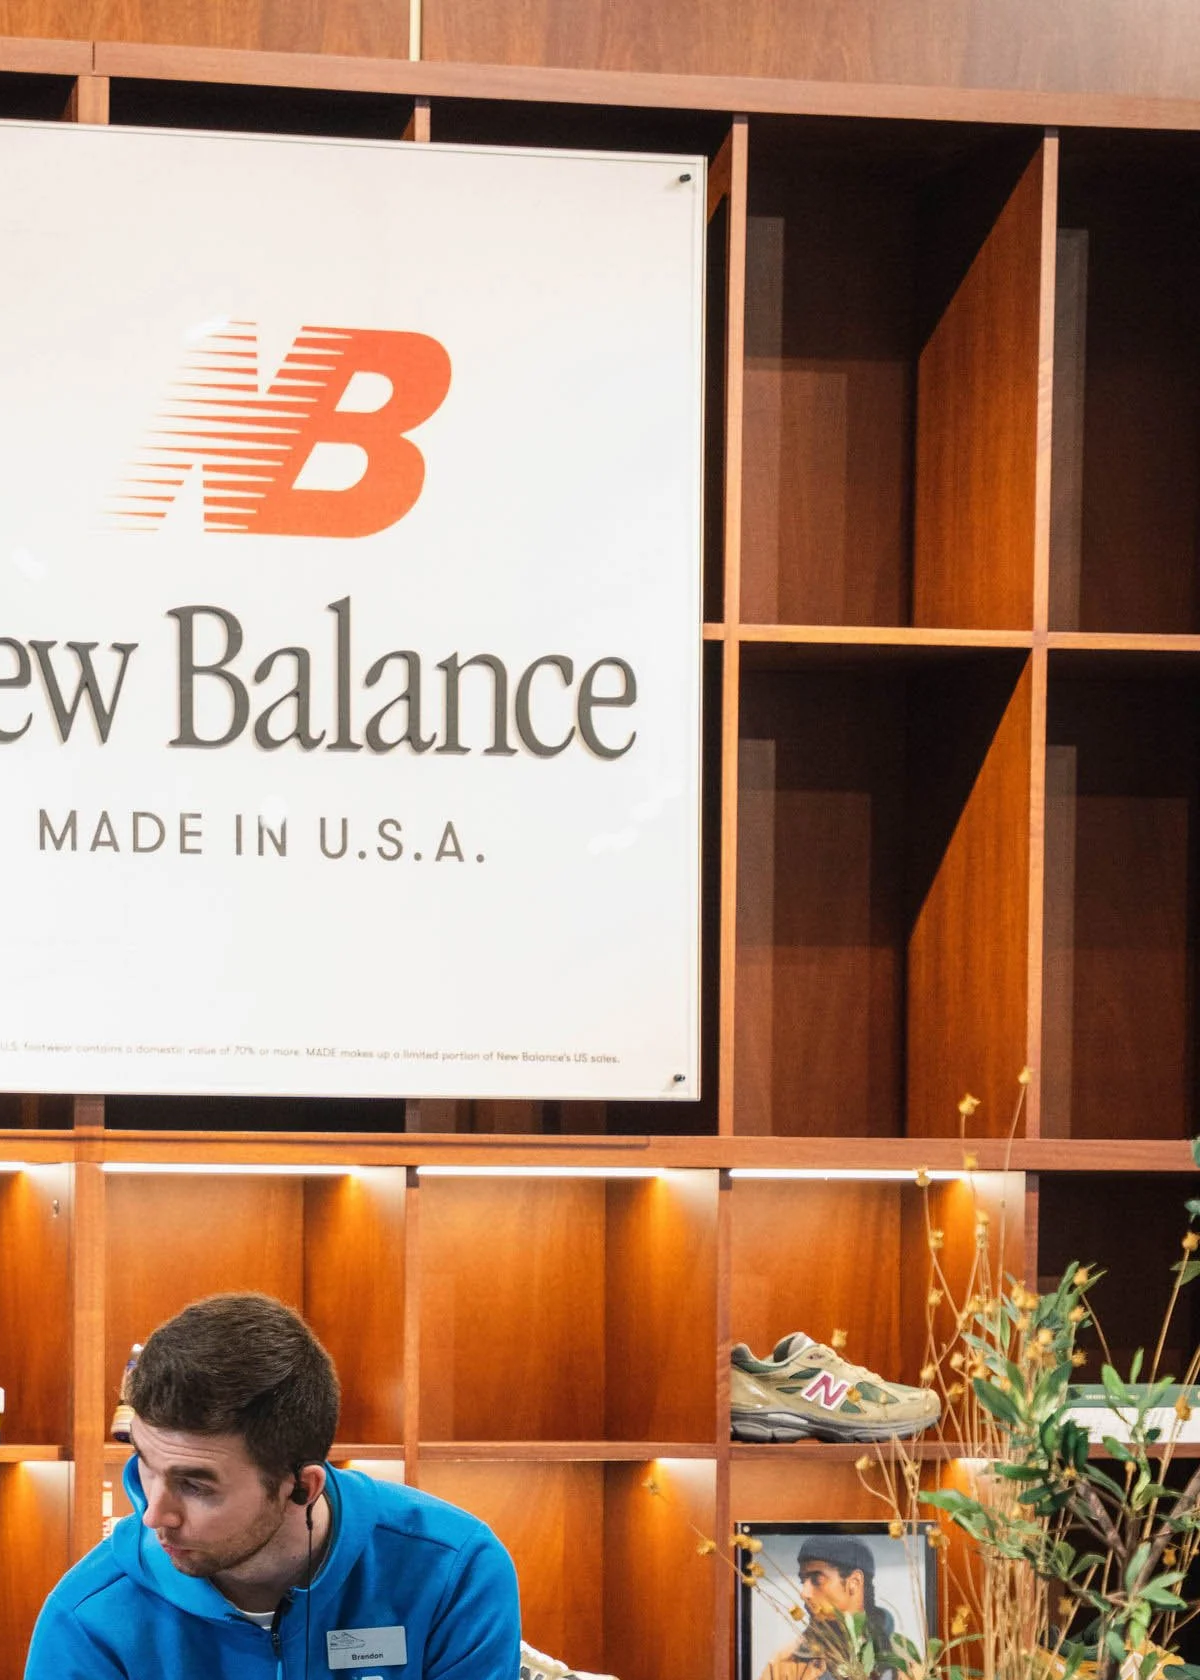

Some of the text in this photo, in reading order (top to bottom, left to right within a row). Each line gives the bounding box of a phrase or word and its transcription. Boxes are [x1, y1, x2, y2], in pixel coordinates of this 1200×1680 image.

[166, 594, 640, 762] Balance
[37, 809, 488, 864] MADE IN U.S.A.
[76, 1044, 122, 1053] contains
[136, 1045, 182, 1054] domestic
[188, 1046, 216, 1054] value
[219, 1046, 230, 1055] of
[233, 1046, 255, 1055] 70%
[306, 1048, 337, 1057] MADE
[340, 1049, 373, 1058] makes
[377, 1051, 390, 1061] up
[403, 1049, 439, 1059] limited
[442, 1052, 480, 1062] portion
[483, 1052, 494, 1061] of
[497, 1052, 519, 1061] New
[522, 1052, 571, 1062] Balance's
[574, 1053, 588, 1062] US
[591, 1053, 621, 1063] sales.
[801, 1370, 850, 1410] N
[351, 1652, 384, 1661] Brandon
